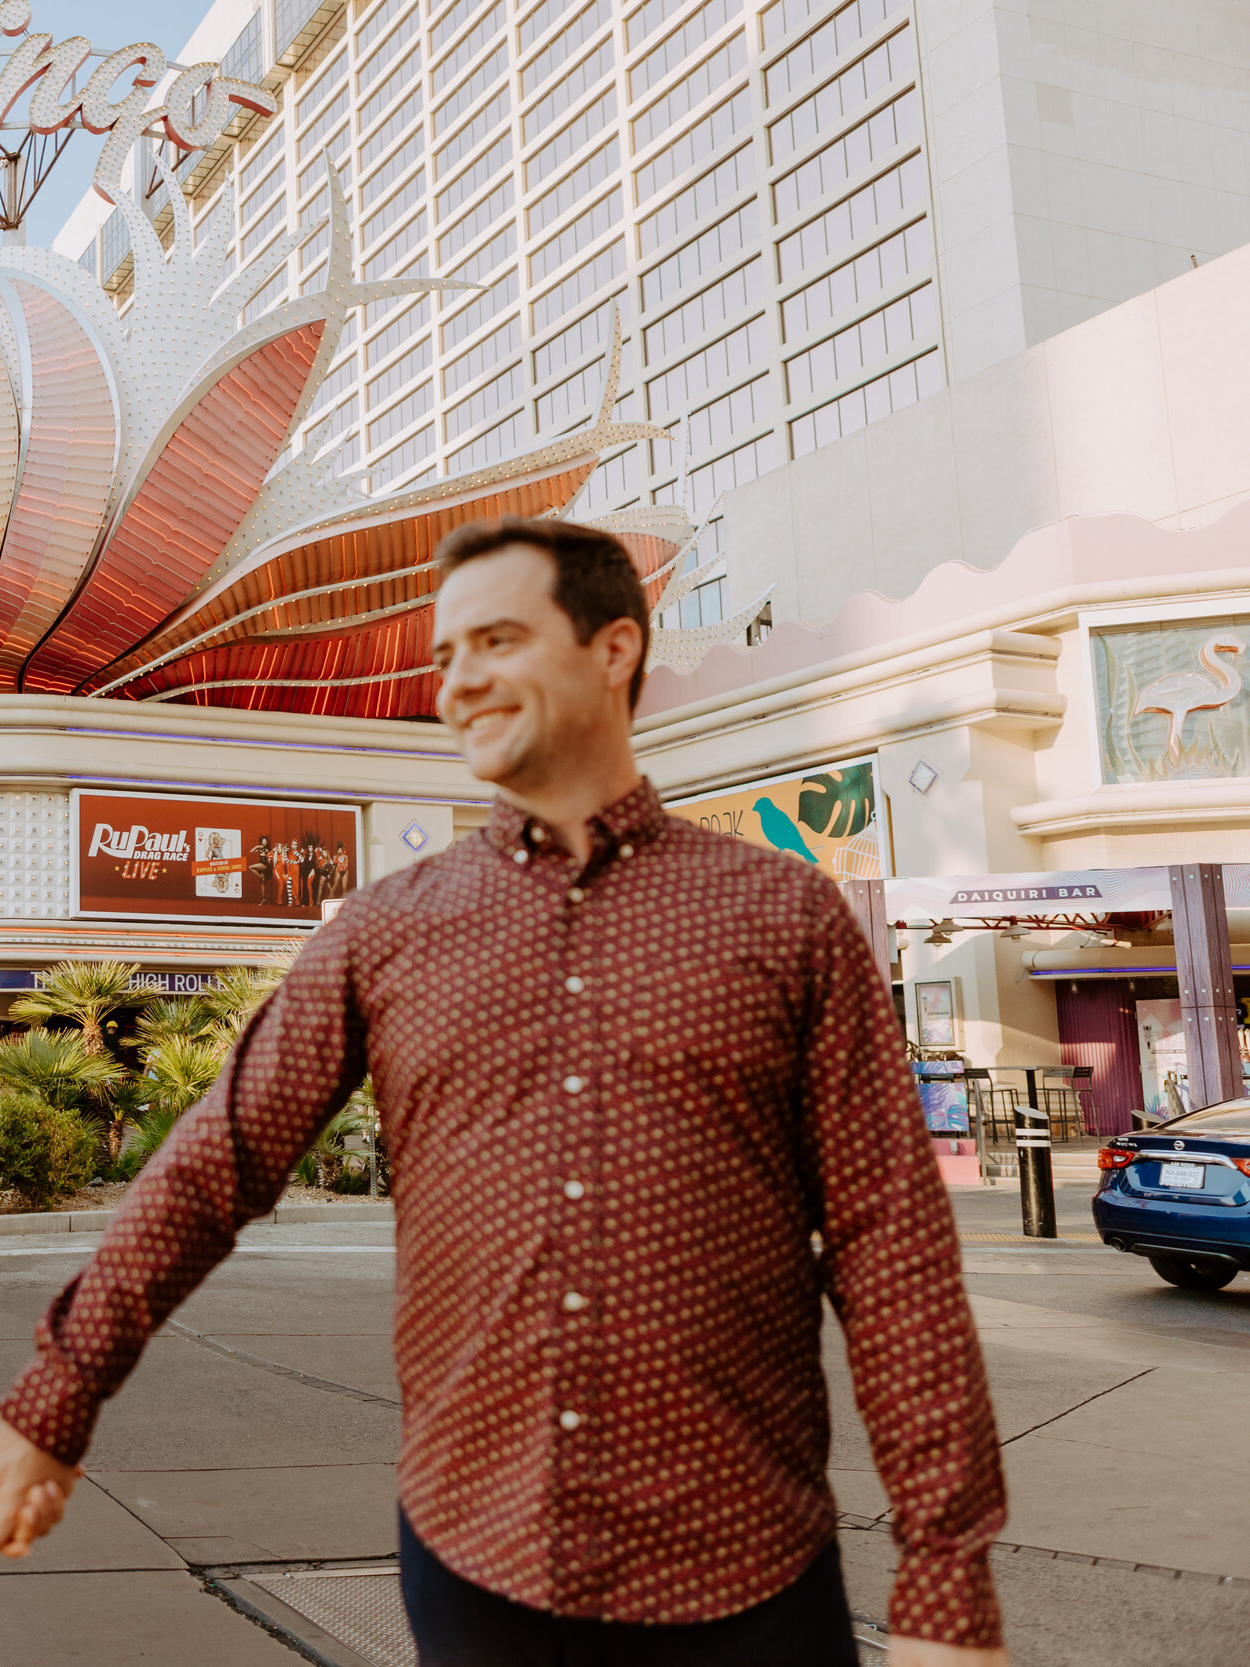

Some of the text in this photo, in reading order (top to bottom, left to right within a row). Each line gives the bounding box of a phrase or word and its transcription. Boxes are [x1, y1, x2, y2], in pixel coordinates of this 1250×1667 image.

[88, 823, 190, 859] RuPaul's
[133, 850, 189, 862] DRAG RACE
[122, 860, 162, 880] LIVE
[957, 887, 1096, 902] DAIQUIRI BAR
[129, 973, 170, 991] HIGH
